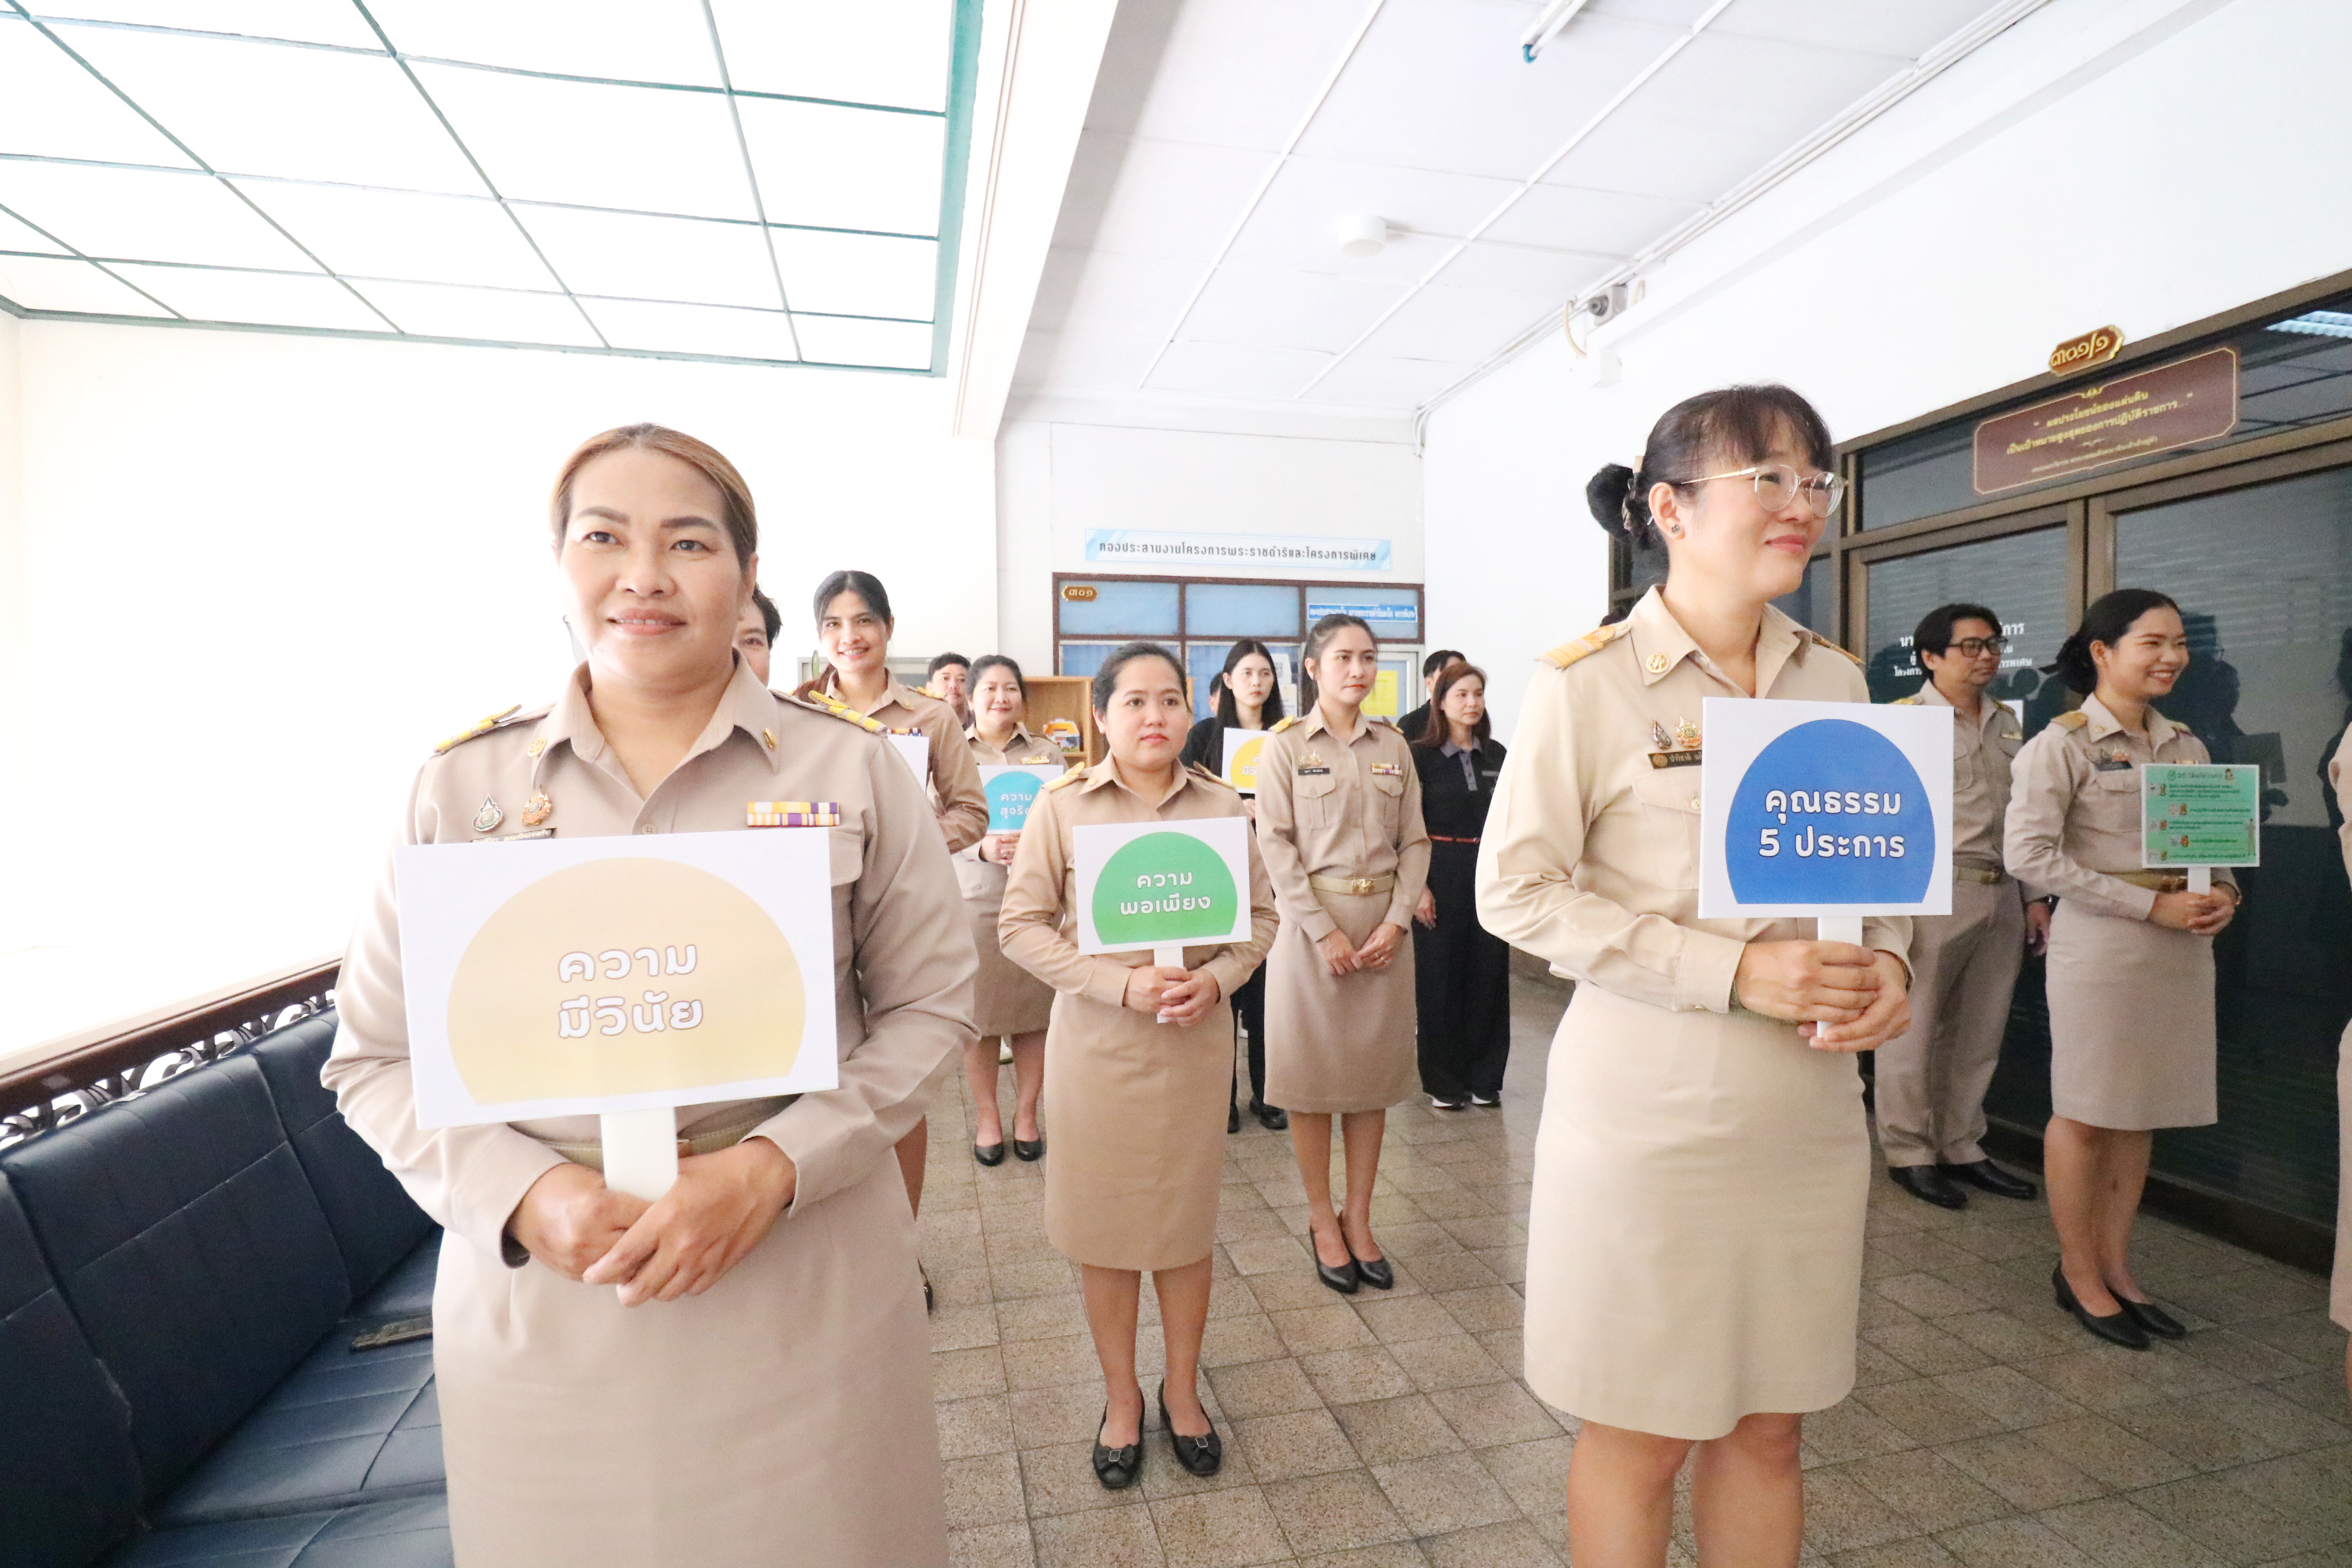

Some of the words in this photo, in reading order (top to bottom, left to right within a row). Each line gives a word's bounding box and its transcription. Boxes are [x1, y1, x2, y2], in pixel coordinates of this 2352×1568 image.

[1099, 541, 1376, 561] กองประสานงานโครงการพระราชดำริและโครงการพิเศษ
[1001, 793, 1033, 802] ความ
[1765, 789, 1902, 825] คุณธรรม
[1758, 828, 1781, 858] 5
[1795, 825, 1906, 859] ประการ
[1136, 871, 1193, 888] ความ
[1120, 892, 1211, 915] พอเพียง
[558, 944, 698, 983] ความ
[558, 990, 704, 1039] มีวินัย
